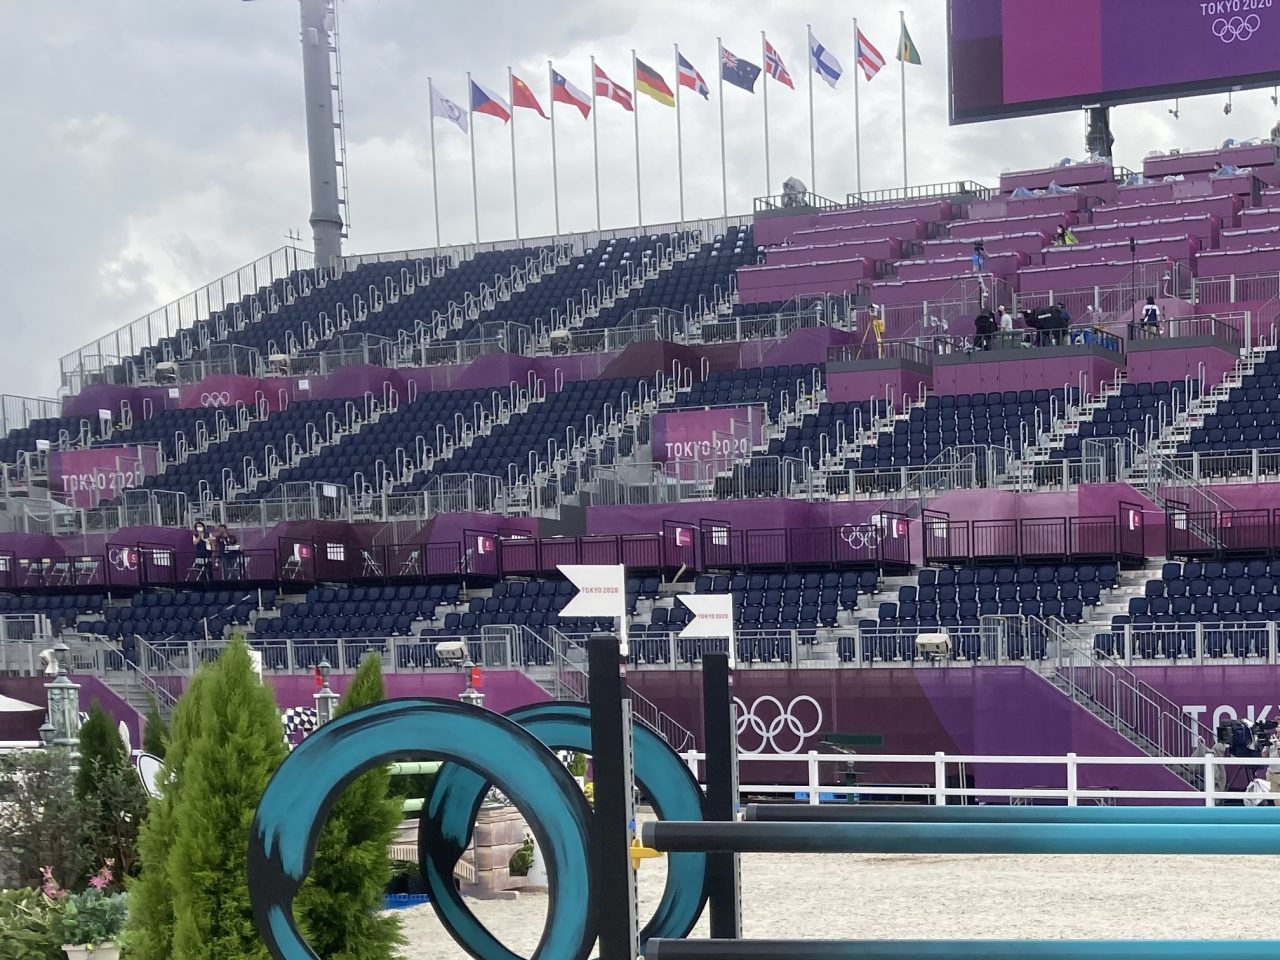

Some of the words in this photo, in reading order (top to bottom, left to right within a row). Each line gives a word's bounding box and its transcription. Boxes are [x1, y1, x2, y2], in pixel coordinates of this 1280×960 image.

[1200, 0, 1240, 16] TOKYO
[1243, 0, 1272, 10] 2020
[581, 586, 602, 594] TOKYO
[603, 586, 619, 594] 2020
